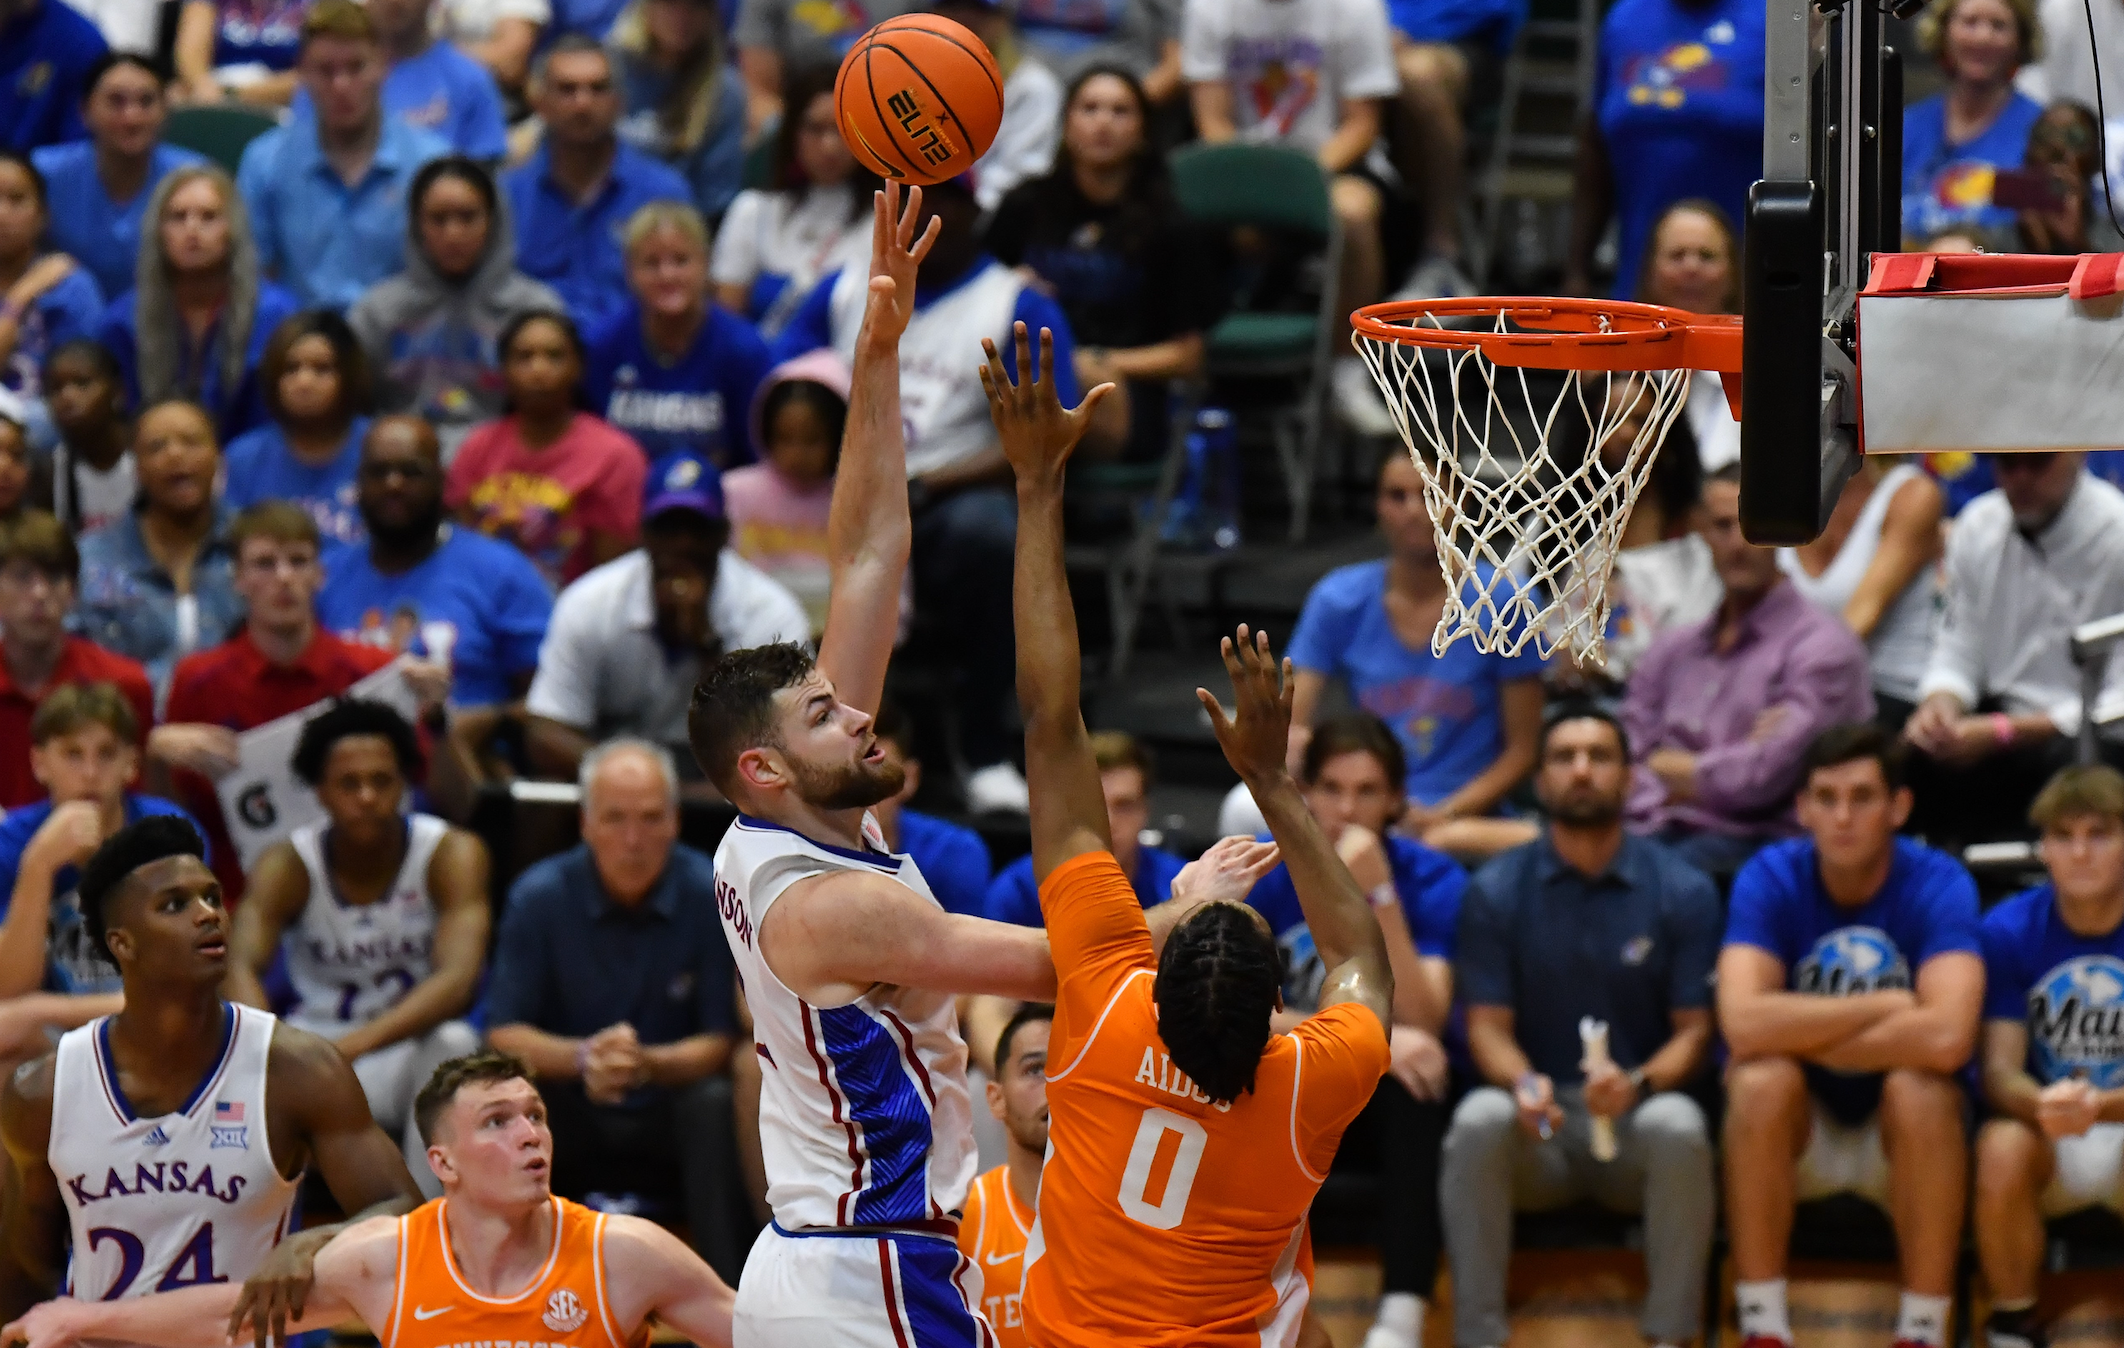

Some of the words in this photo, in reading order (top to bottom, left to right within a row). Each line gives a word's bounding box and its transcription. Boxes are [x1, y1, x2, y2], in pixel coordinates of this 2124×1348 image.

[887, 89, 951, 167] ELITE
[239, 782, 277, 831] G
[66, 1161, 247, 1207] KANSAS
[1117, 1107, 1208, 1230] 0
[88, 1221, 229, 1302] 24
[548, 1290, 579, 1321] SEC
